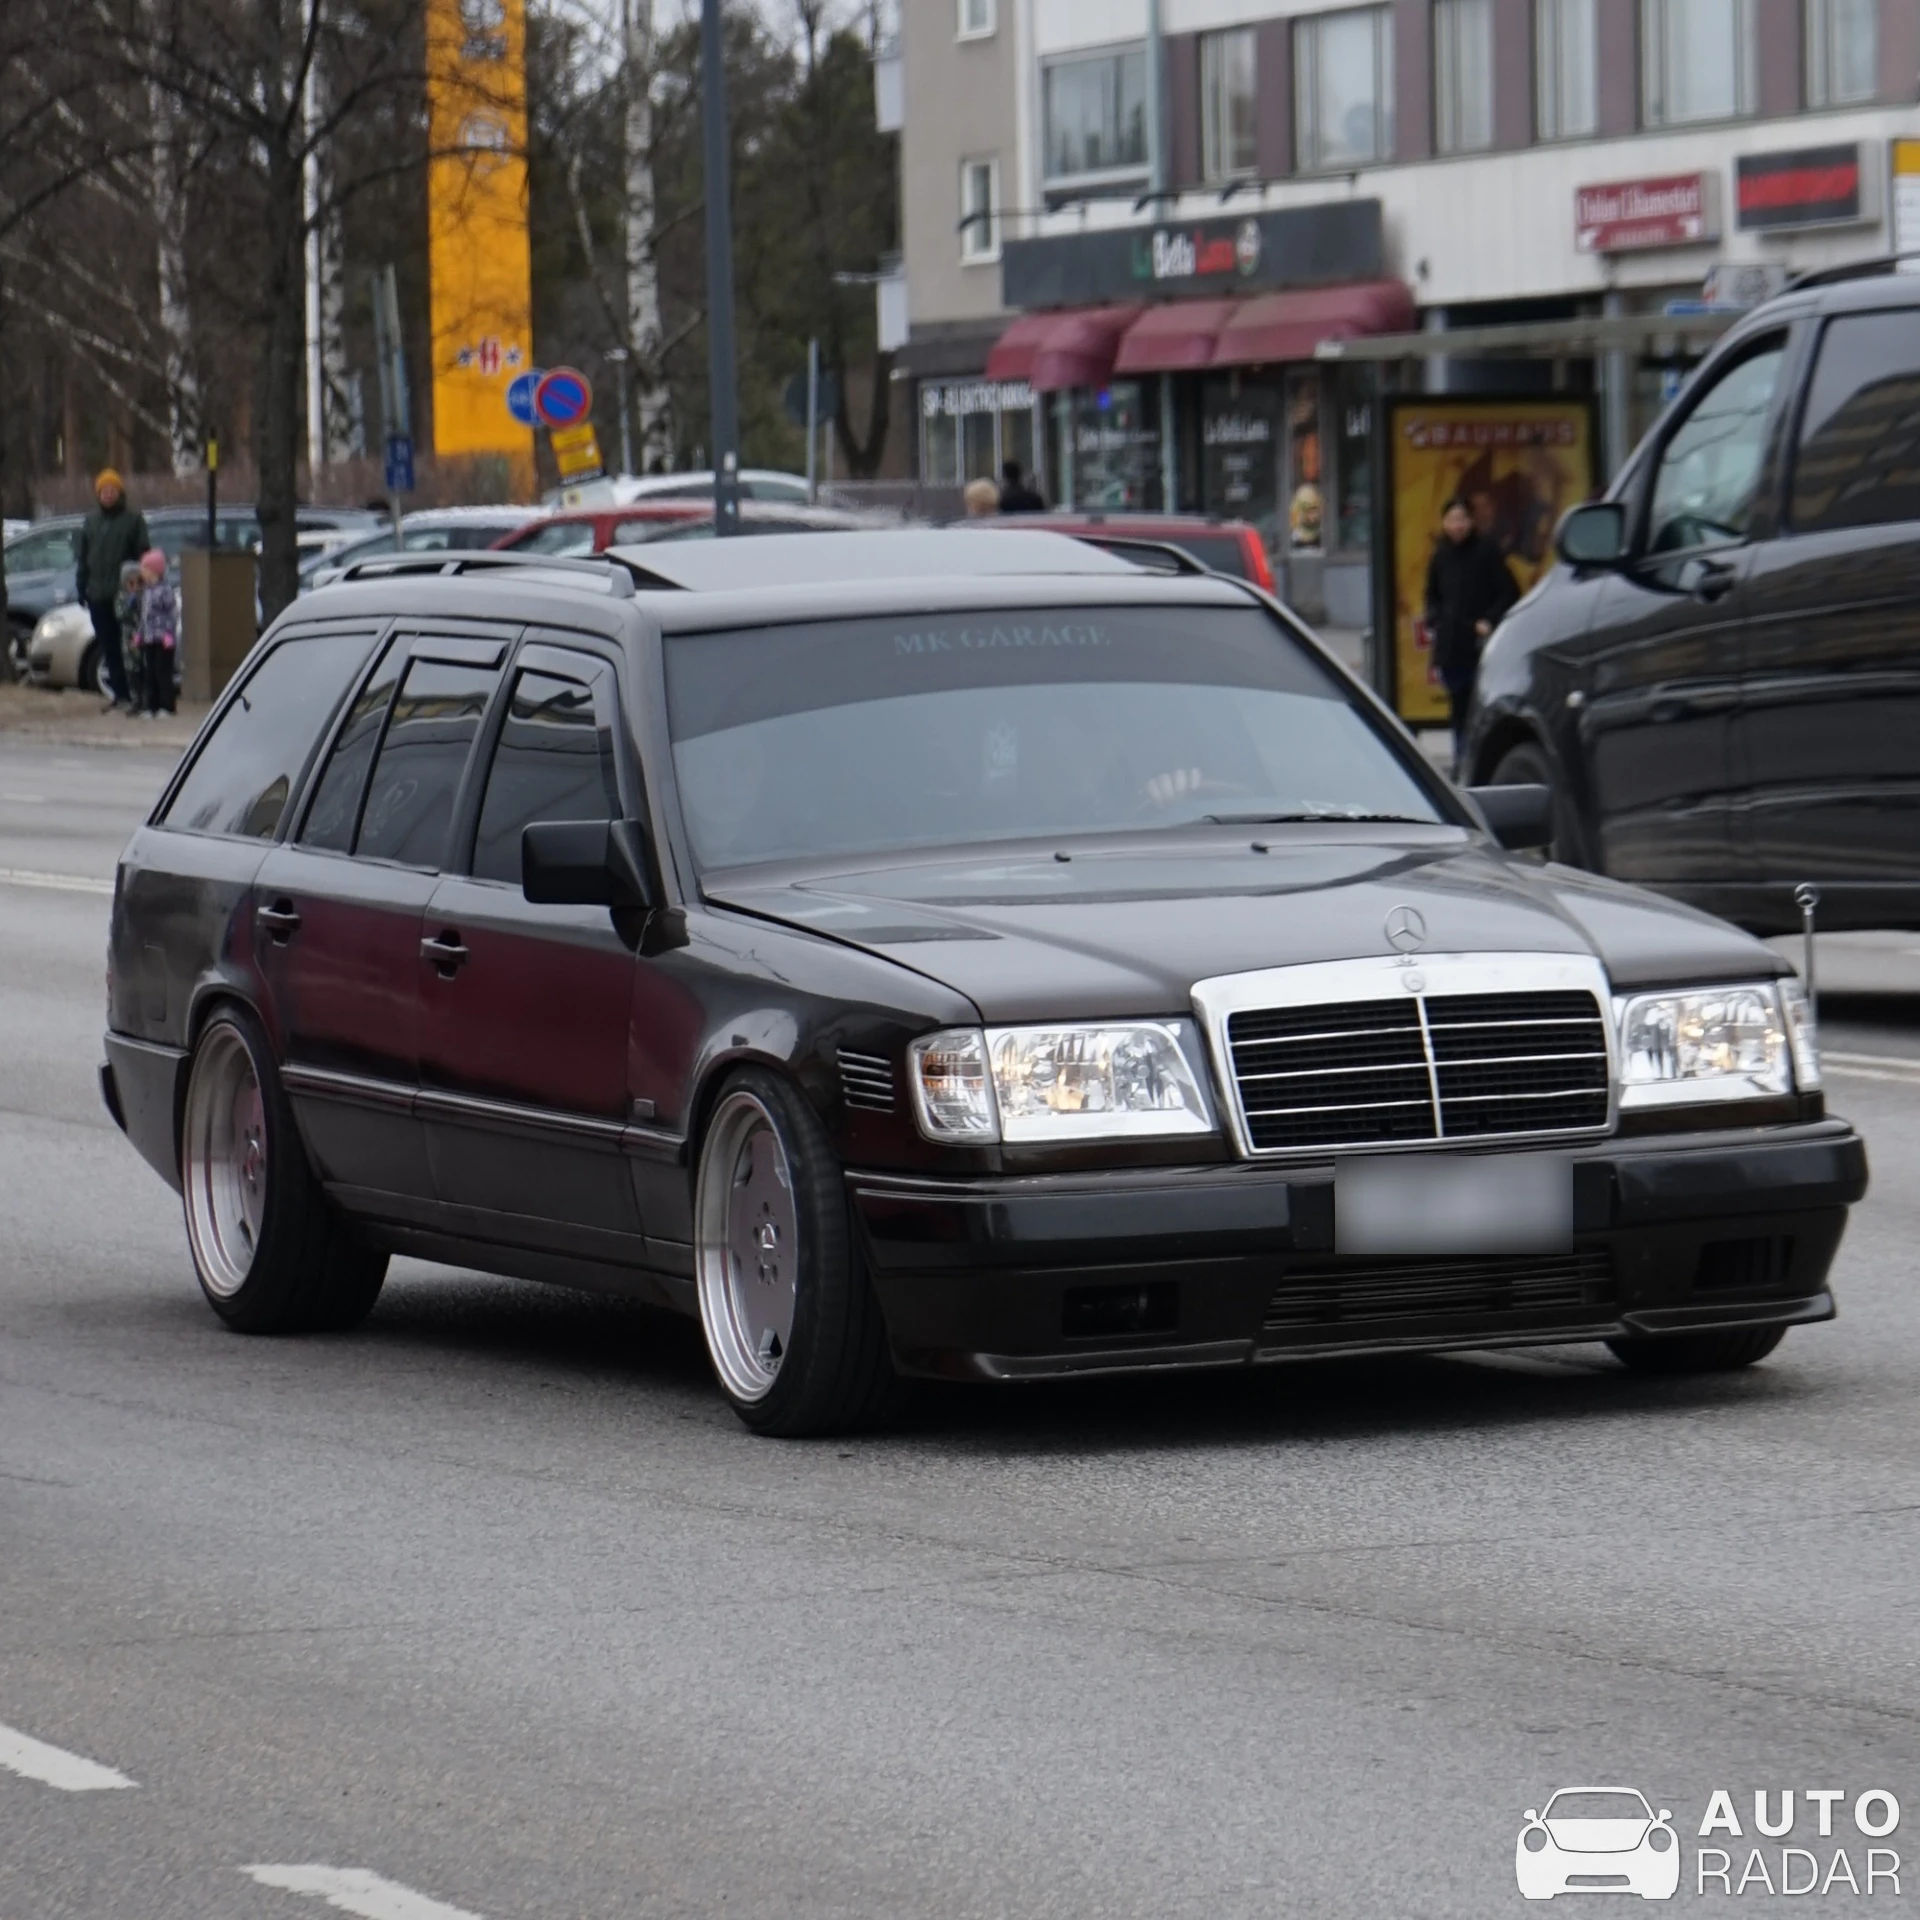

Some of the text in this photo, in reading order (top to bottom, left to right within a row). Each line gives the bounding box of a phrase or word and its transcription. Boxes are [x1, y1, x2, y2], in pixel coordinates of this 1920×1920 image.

[1431, 421, 1573, 446] BAUHAUS
[894, 625, 1112, 655] MK GARAGE
